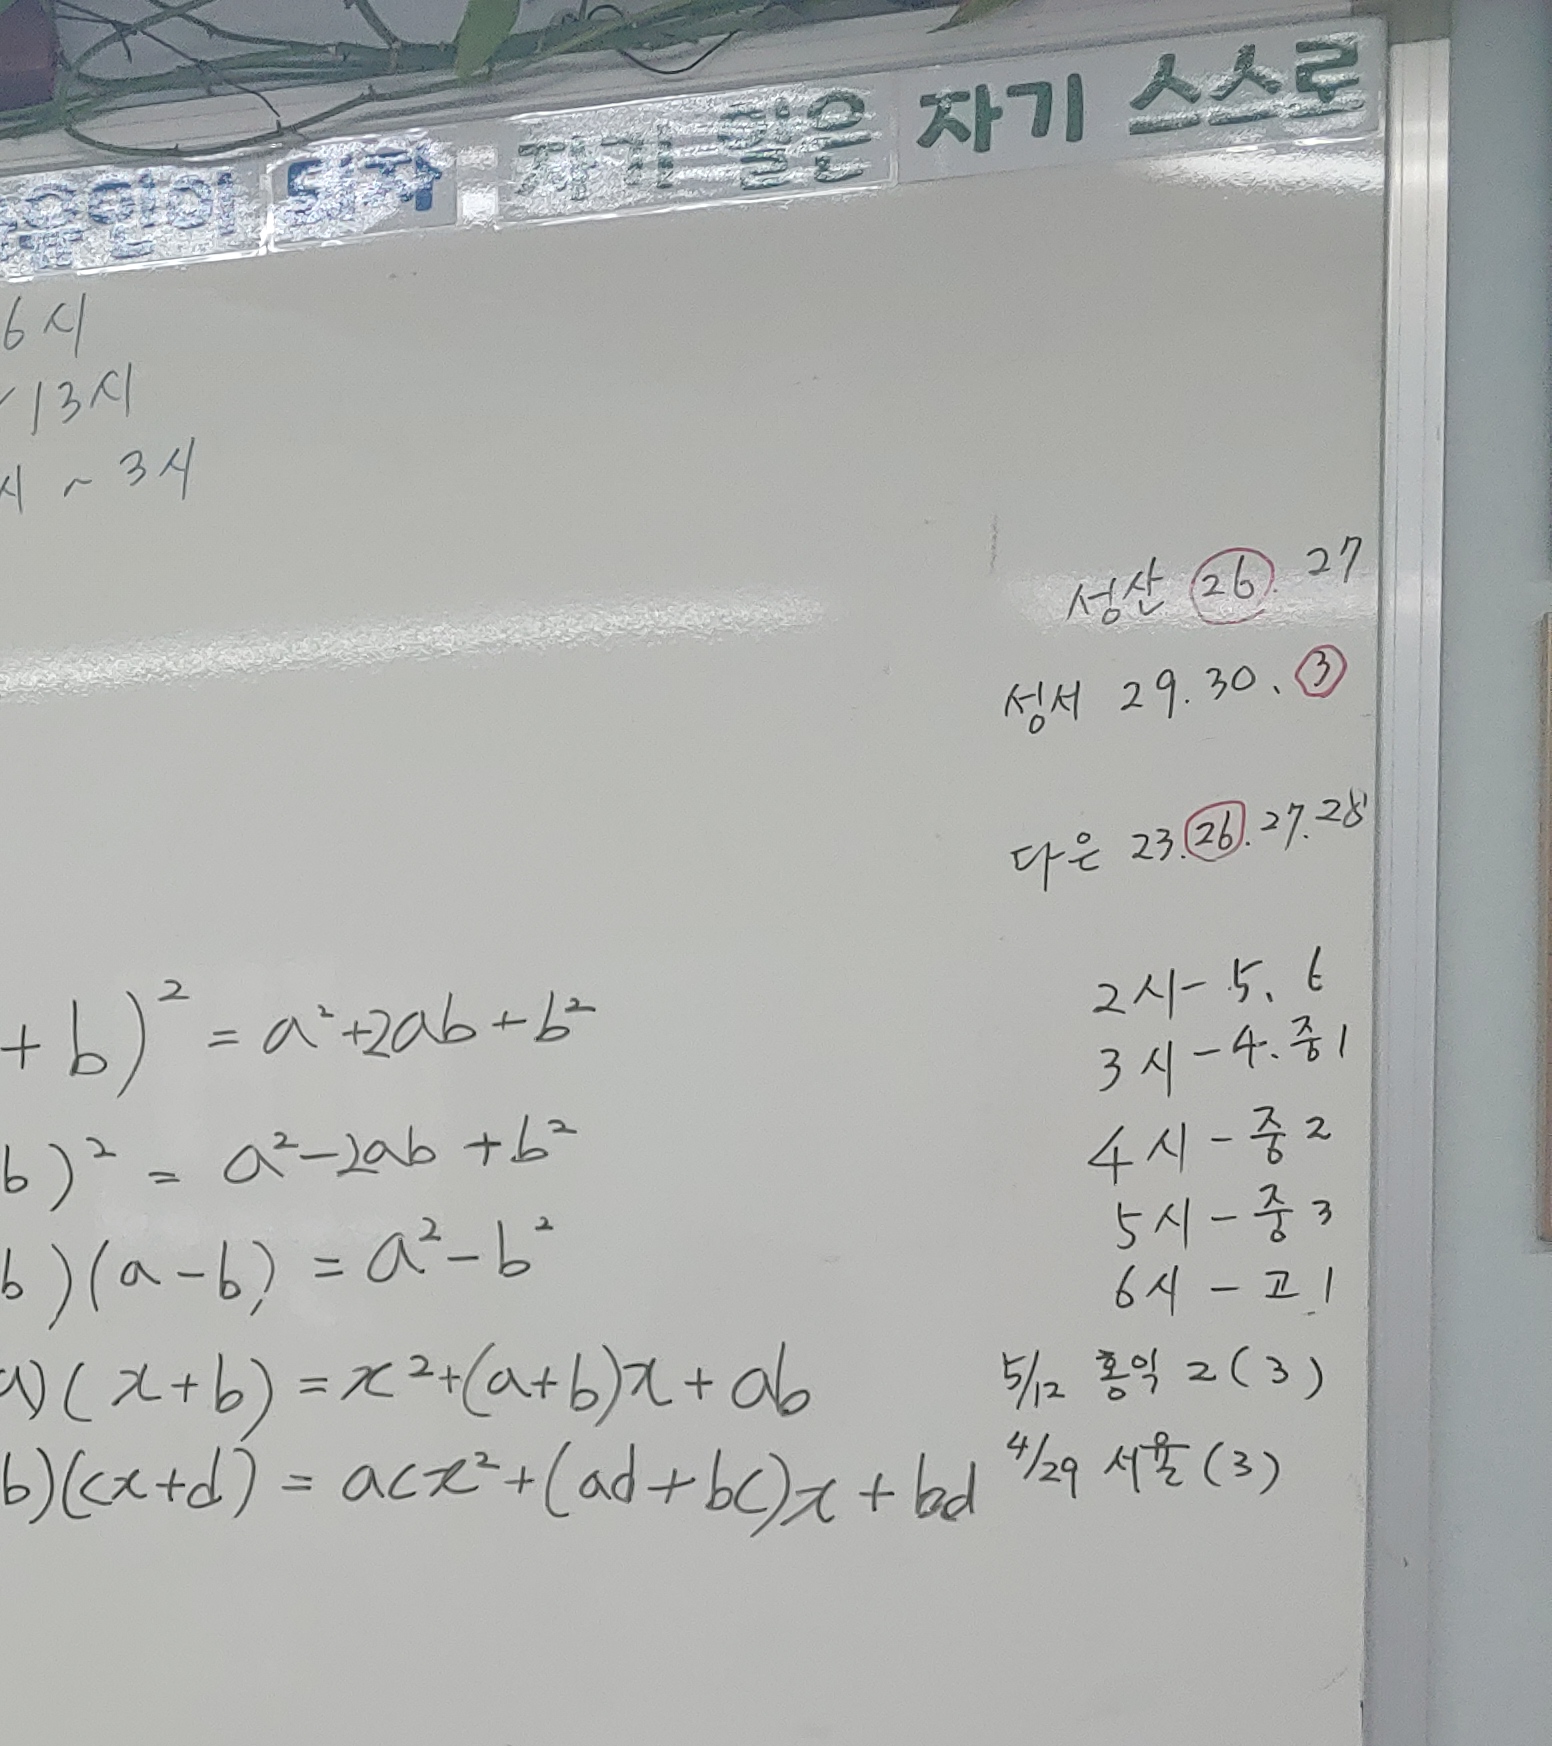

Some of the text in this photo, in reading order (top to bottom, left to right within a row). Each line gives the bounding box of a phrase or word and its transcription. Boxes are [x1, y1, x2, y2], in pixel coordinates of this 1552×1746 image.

[917, 74, 1084, 153] 자기
[1129, 36, 1365, 134] 스스로
[1067, 557, 1164, 625] 성산
[1005, 680, 1080, 733] 성서
[1012, 832, 1101, 891] 다은
[1096, 1349, 1157, 1400] 홍익
